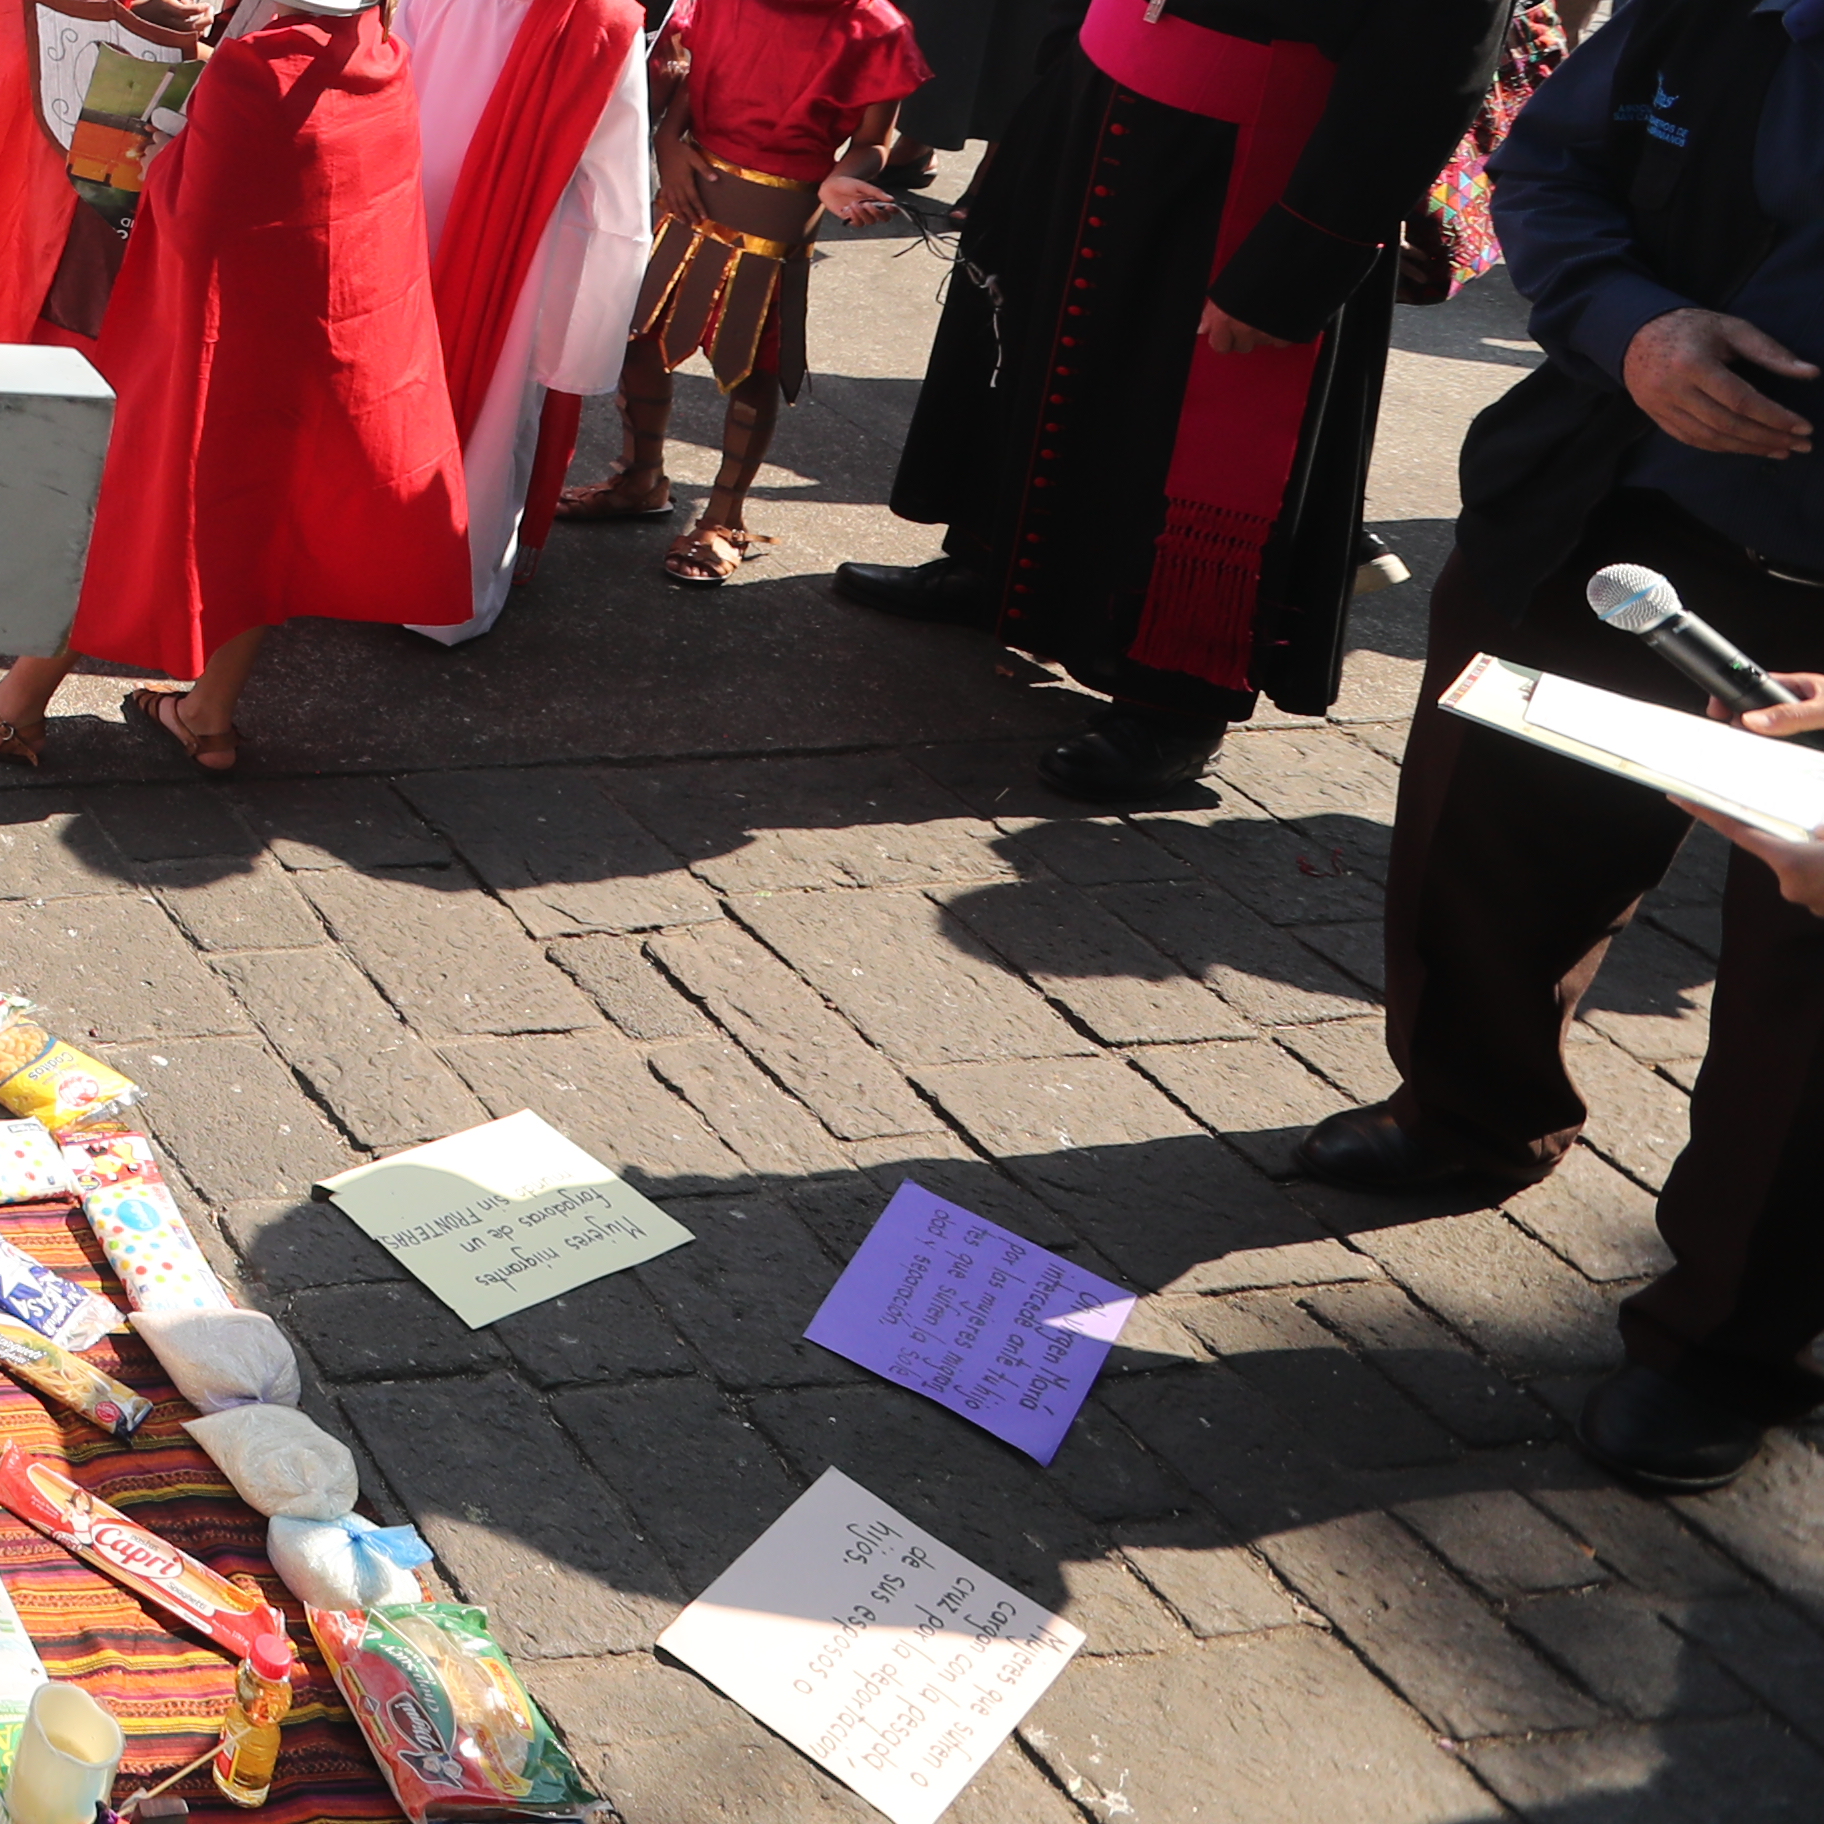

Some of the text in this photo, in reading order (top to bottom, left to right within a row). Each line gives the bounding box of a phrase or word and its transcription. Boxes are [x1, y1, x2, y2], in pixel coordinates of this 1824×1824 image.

[28, 1049, 75, 1081] Coditos
[476, 1195, 511, 1213] sin
[514, 1169, 573, 1199] mundo
[459, 1186, 613, 1254] forjadoras de un
[963, 1225, 999, 1247] tes
[475, 1214, 648, 1293] Mujeres migrantes
[944, 1250, 974, 1280] que
[998, 1236, 1027, 1266] por
[988, 1267, 1027, 1289] las
[922, 1284, 962, 1326] sufren
[954, 1291, 997, 1350] mujeres
[1070, 1291, 1107, 1318] Oh
[908, 1326, 946, 1345] la
[953, 1262, 1075, 1410] intercede ante tu hijo
[1018, 1366, 1072, 1416] María
[95, 1526, 181, 1576] Capri
[842, 1520, 904, 1565] hijos.
[936, 1576, 976, 1615] cruz
[792, 1545, 937, 1695] de sus esposos o
[913, 1603, 945, 1643] por
[891, 1639, 937, 1665] la
[860, 1600, 1018, 1772] cargan con la pesada
[909, 1623, 1070, 1788] Mujeres que sufren o
